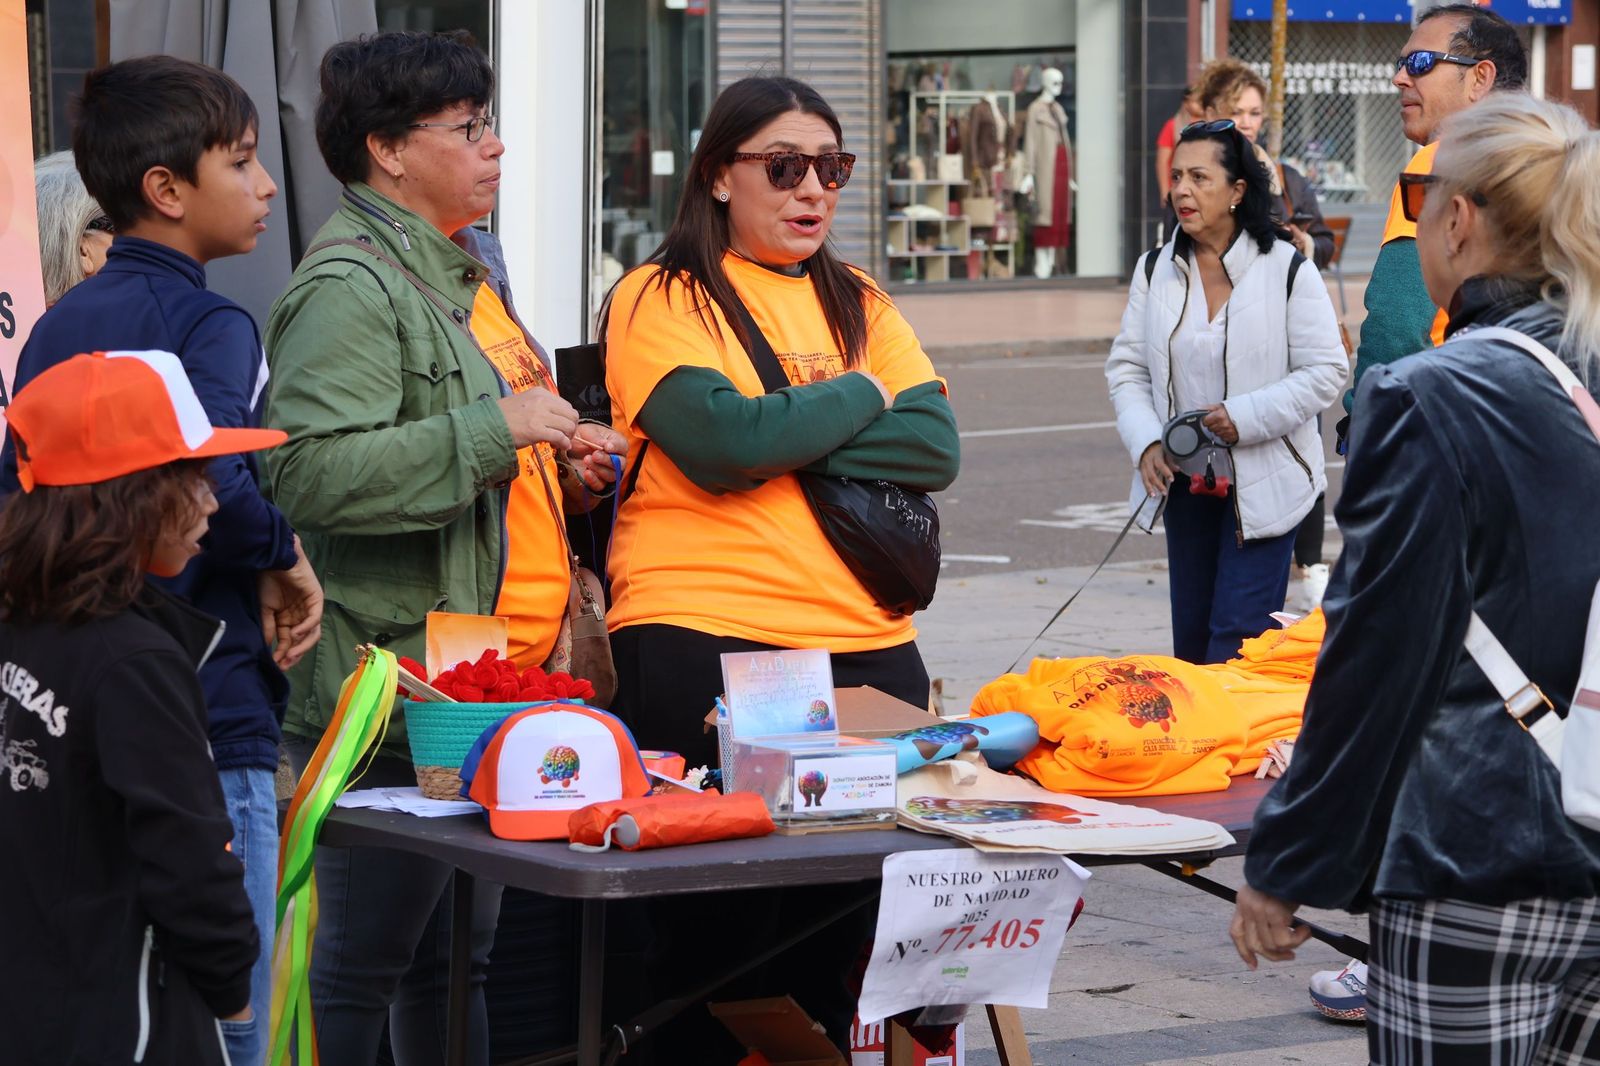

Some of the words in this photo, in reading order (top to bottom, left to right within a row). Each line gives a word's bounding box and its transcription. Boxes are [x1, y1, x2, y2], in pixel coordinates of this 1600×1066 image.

[1096, 677, 1127, 692] DEL
[906, 871, 983, 888] NUESTRO
[992, 867, 1059, 884] NUMERO
[934, 894, 953, 907] DE
[962, 887, 1030, 906] NAVIDAD
[960, 909, 989, 924] 2025
[934, 918, 1045, 954] 77.405
